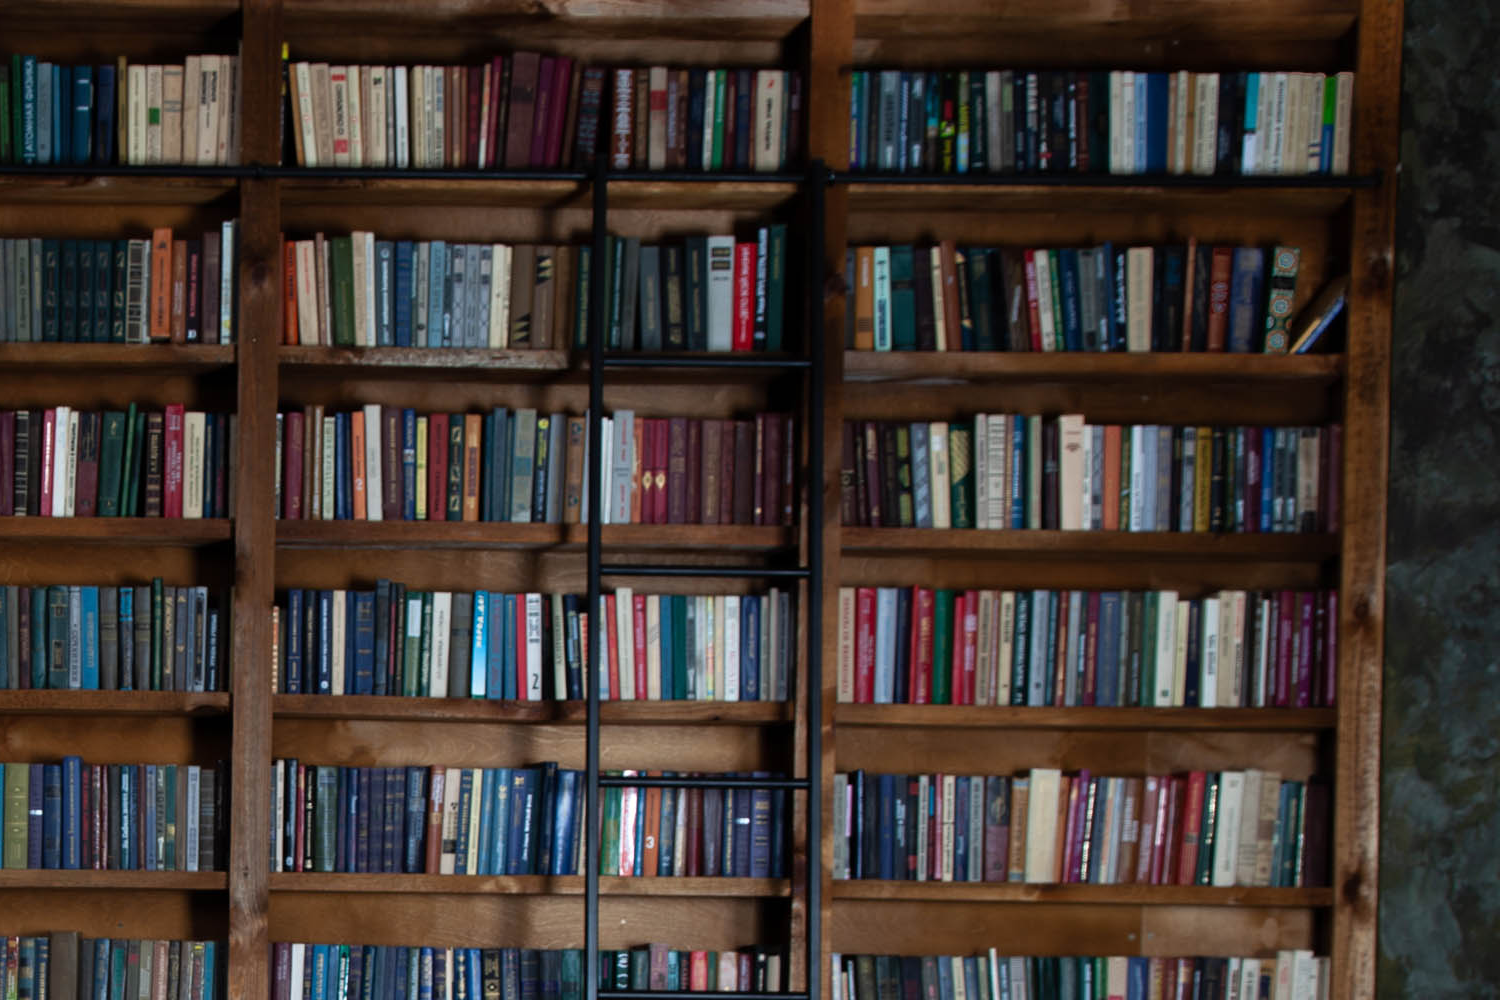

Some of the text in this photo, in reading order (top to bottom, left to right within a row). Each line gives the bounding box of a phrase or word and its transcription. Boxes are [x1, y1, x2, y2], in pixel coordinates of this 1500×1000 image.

[22, 59, 34, 152] АТОМНАЯ ФИЗИКА
[532, 673, 540, 690] 2
